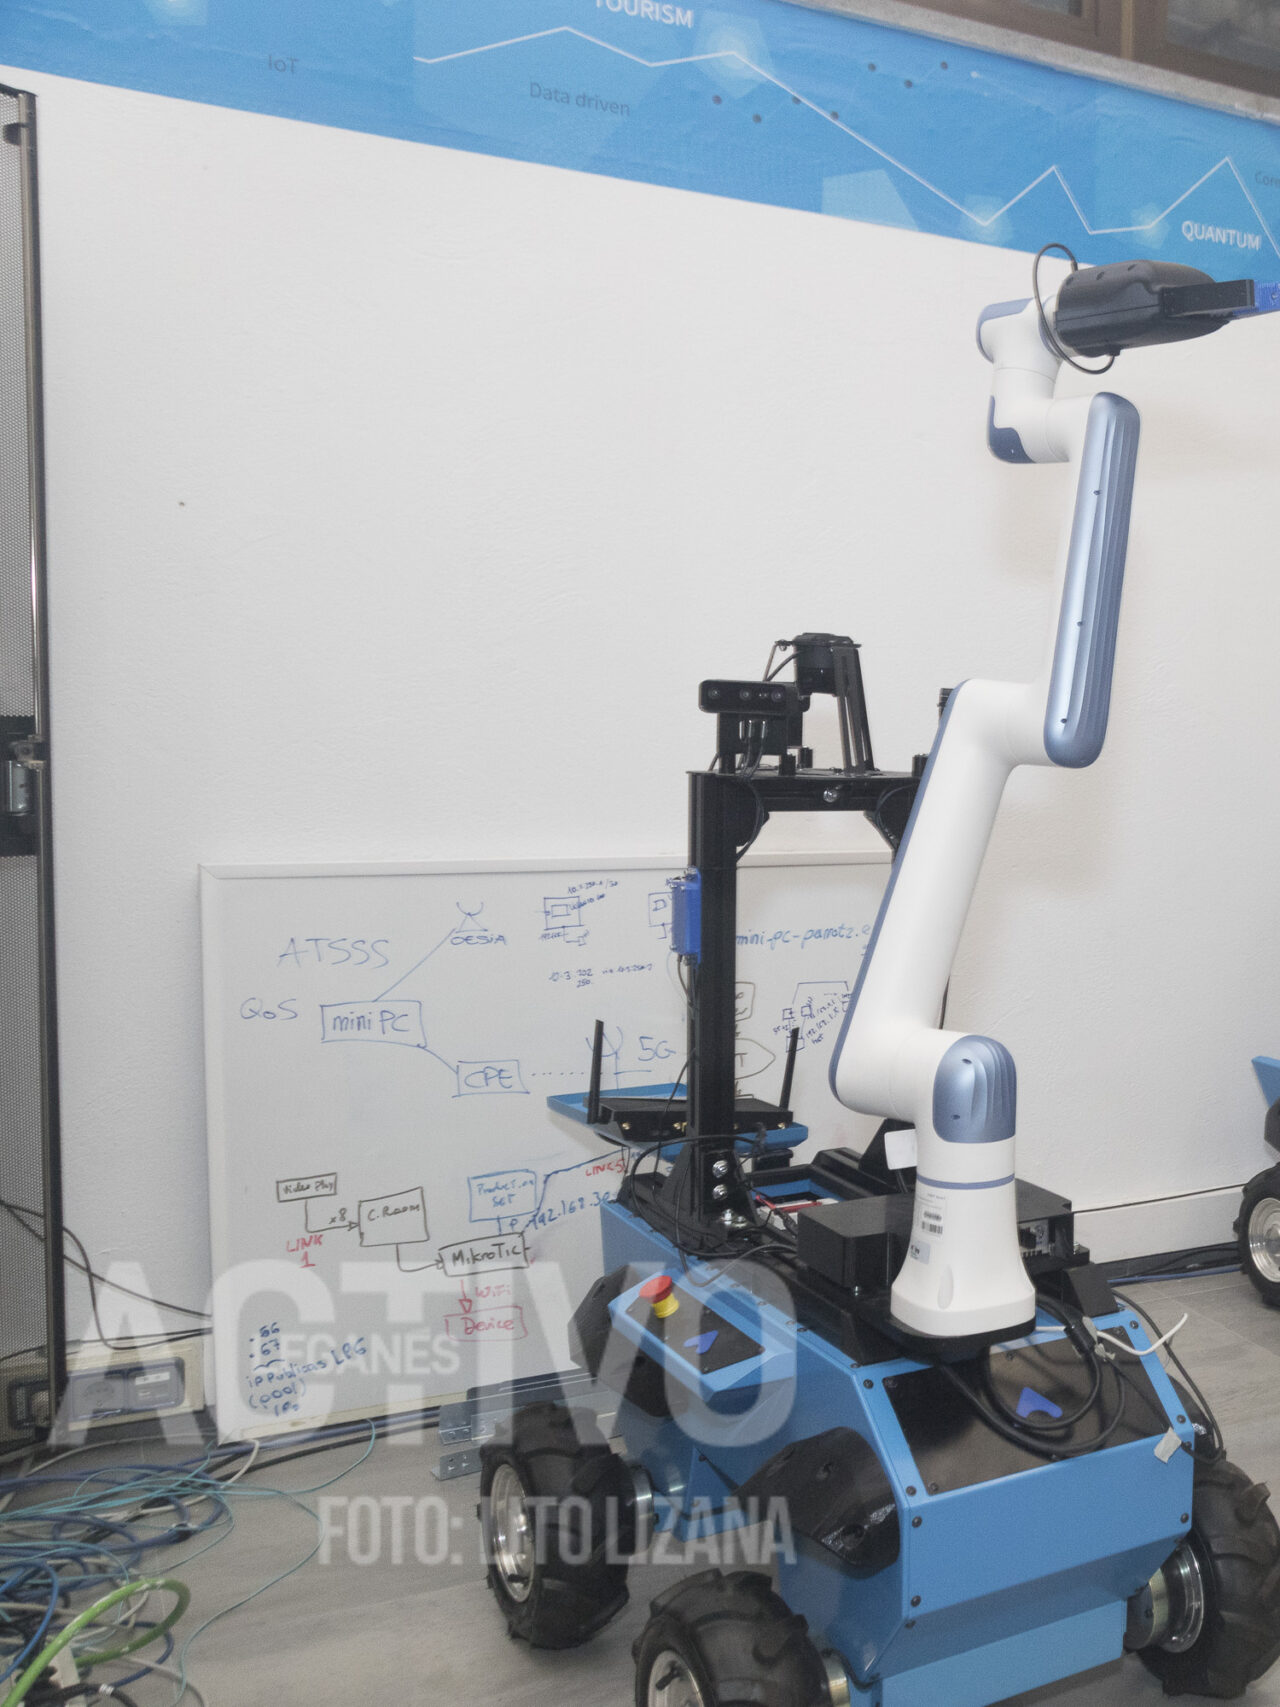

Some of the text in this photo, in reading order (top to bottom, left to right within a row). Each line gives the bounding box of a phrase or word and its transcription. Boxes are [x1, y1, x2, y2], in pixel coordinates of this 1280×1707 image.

[268, 55, 300, 73] IoT
[530, 82, 631, 116] Data driven
[1181, 219, 1262, 251] QUANTUM
[276, 937, 390, 970] ATSSS
[239, 997, 298, 1021] QoS
[332, 1009, 410, 1035] mini PC
[638, 1036, 677, 1062] 5G
[463, 1065, 513, 1089] CPE
[286, 1234, 324, 1253] LINK
[300, 1251, 316, 1268] 1
[461, 1316, 515, 1335] Device
